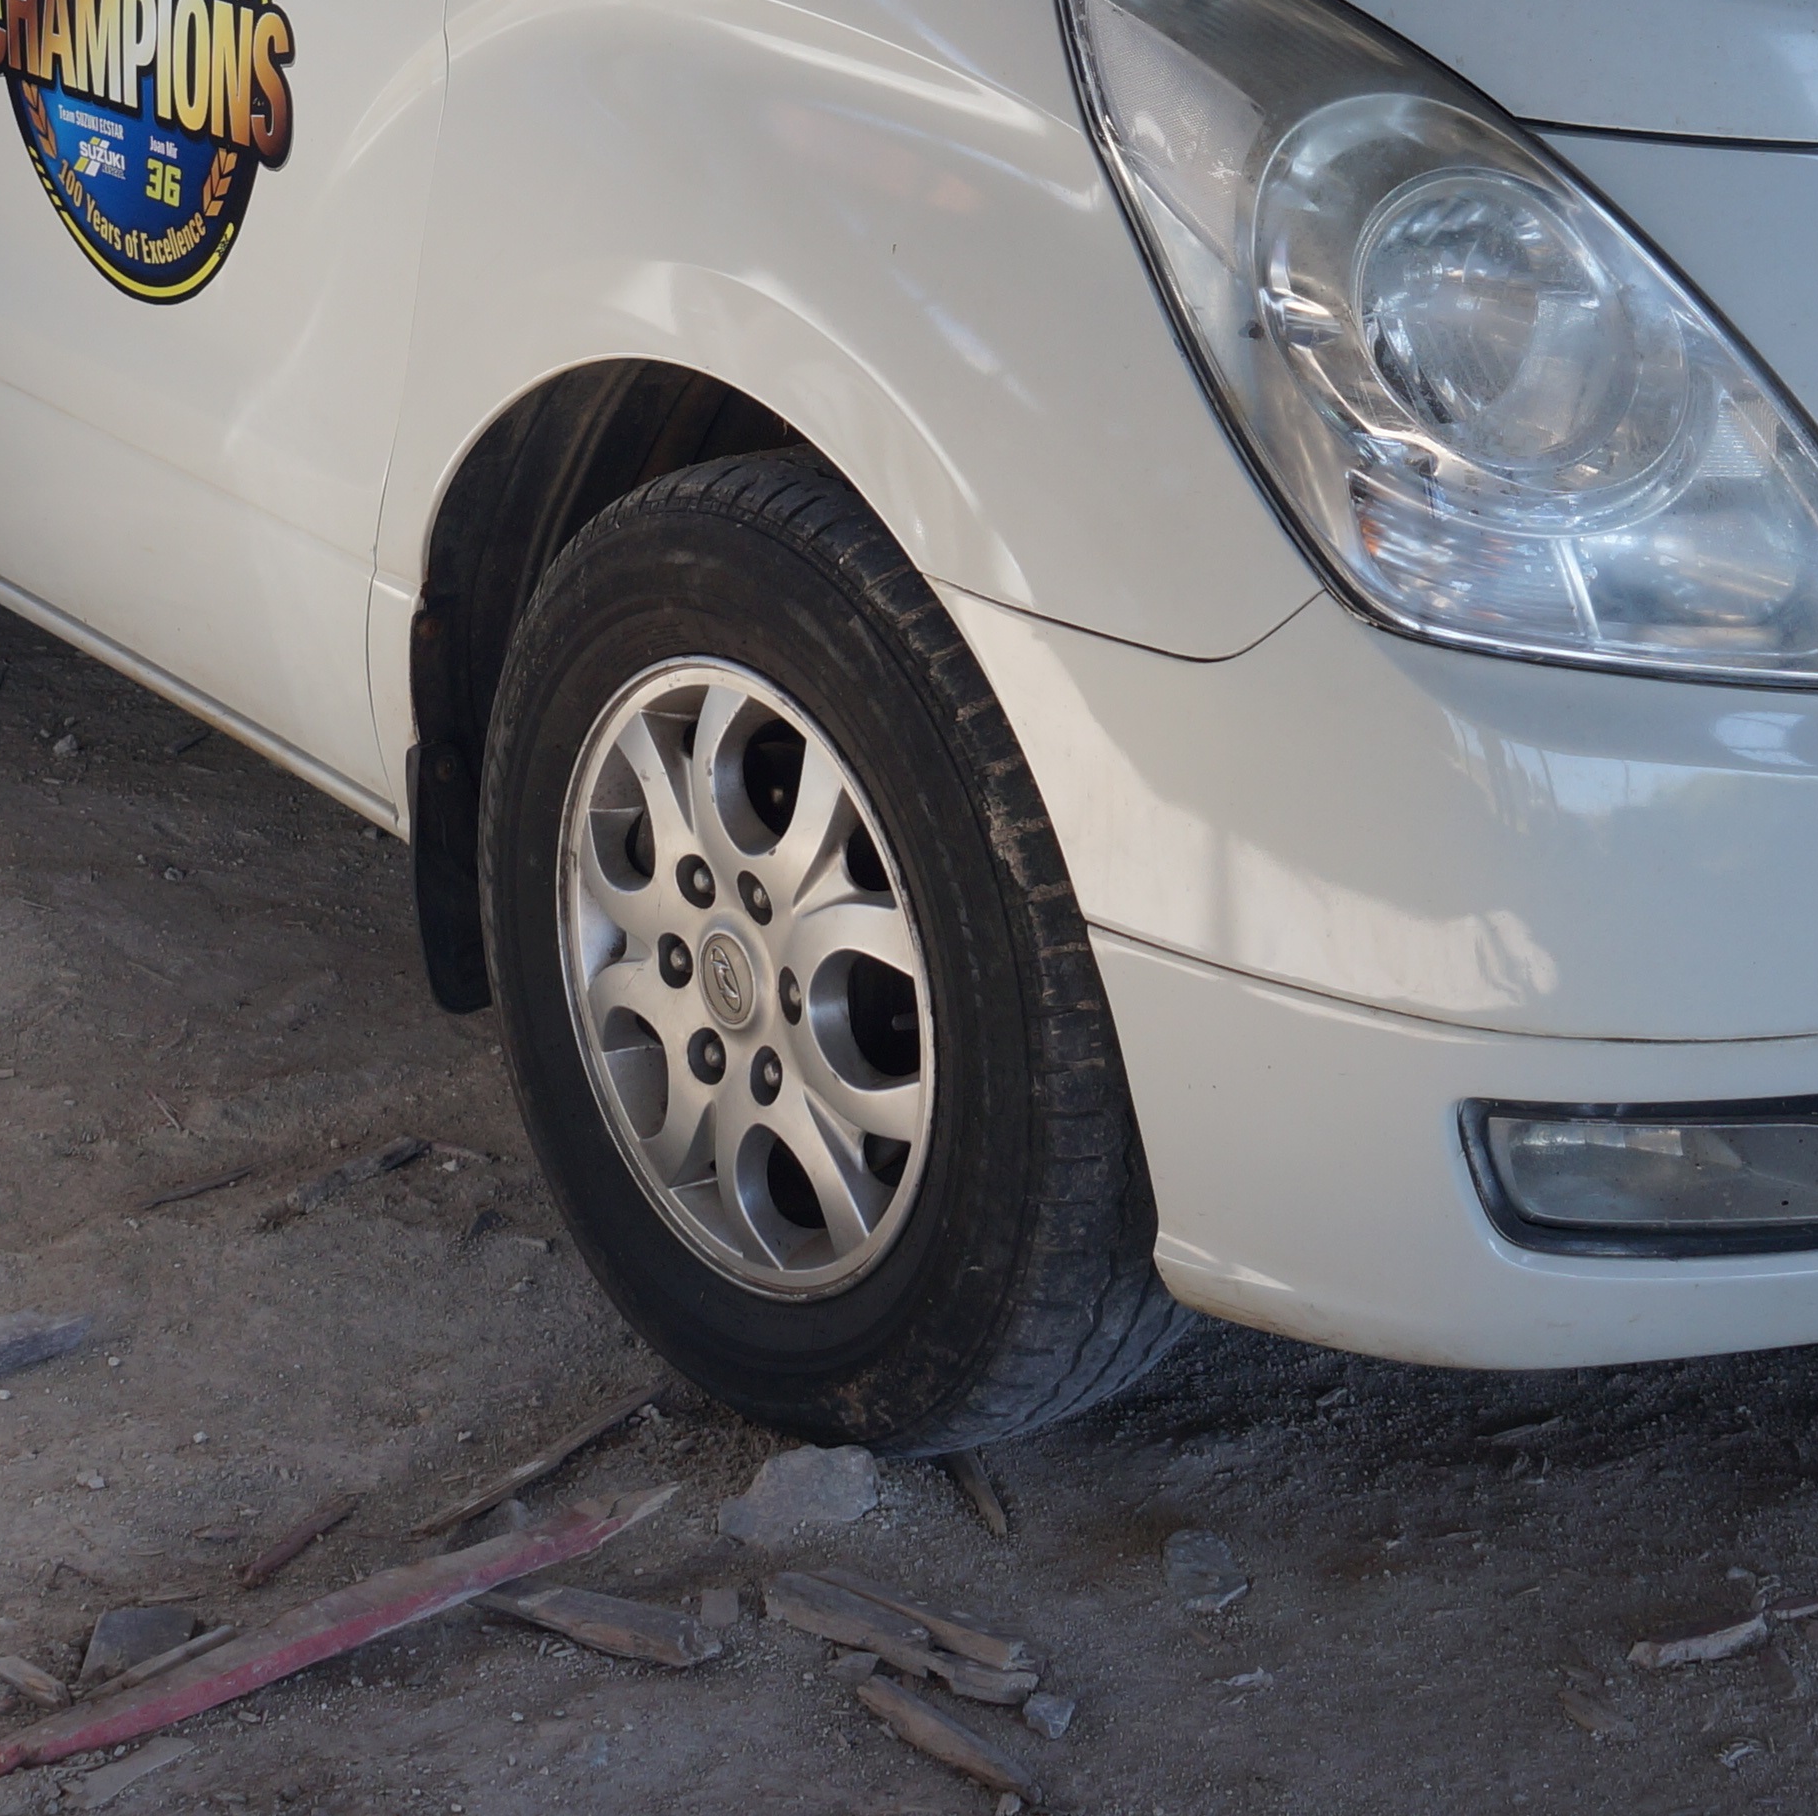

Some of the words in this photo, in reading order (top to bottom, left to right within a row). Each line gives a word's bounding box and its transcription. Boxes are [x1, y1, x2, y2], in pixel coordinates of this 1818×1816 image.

[58, 103, 76, 124] Team
[76, 110, 99, 132] SUZUKI
[99, 117, 124, 141] ECSTAR
[79, 140, 126, 171] SUZUKI
[149, 135, 165, 154] Joan
[146, 157, 181, 208] 36
[57, 158, 83, 208] 100
[85, 192, 122, 251] Years
[124, 229, 140, 261] of
[140, 211, 207, 265] Excellence
